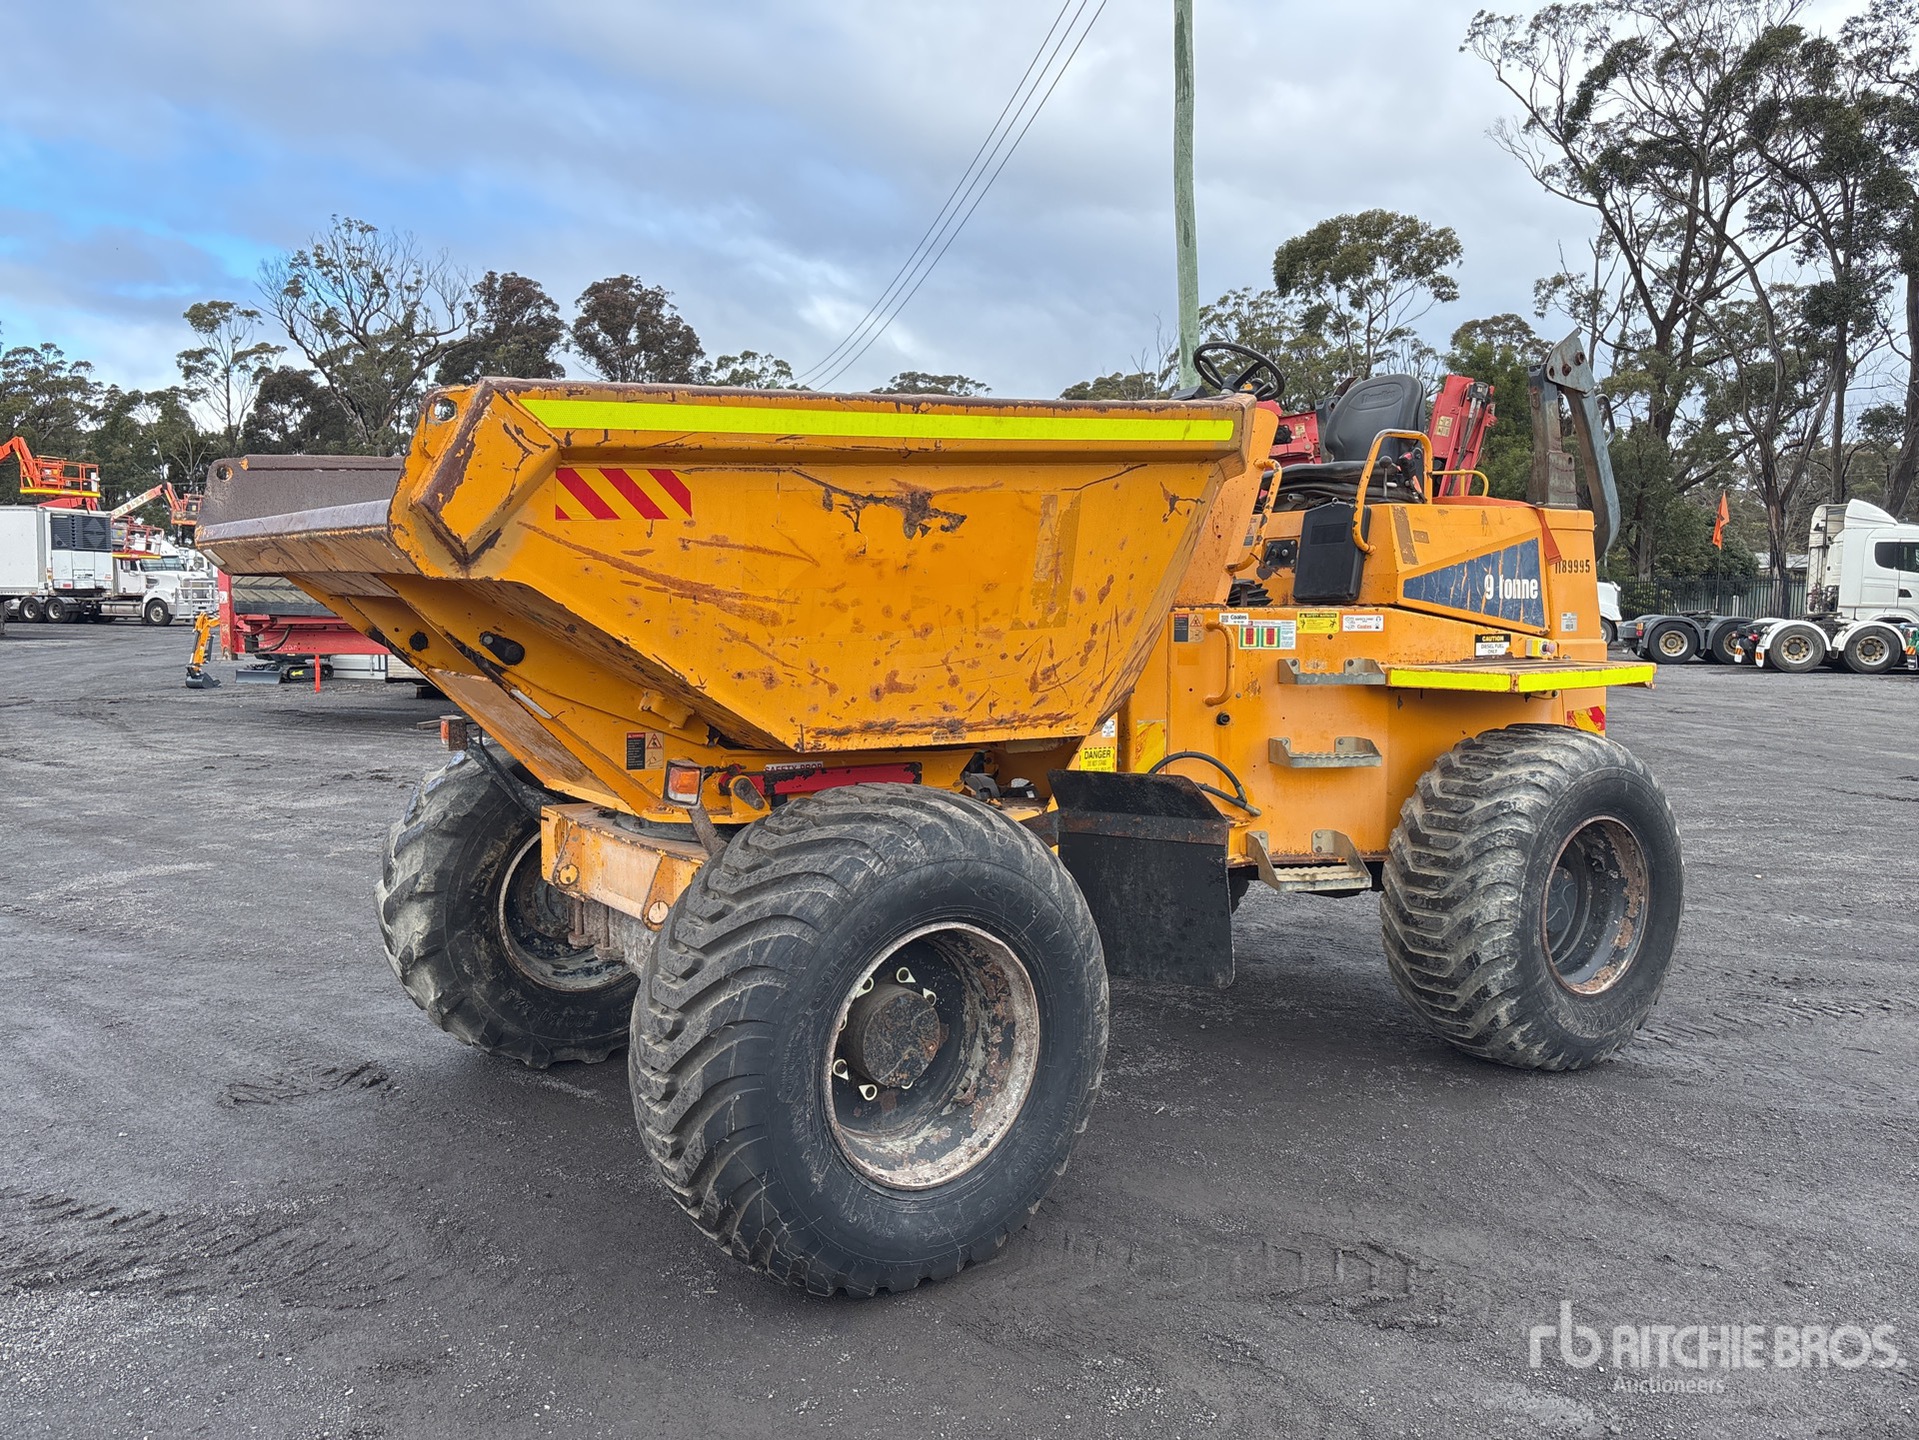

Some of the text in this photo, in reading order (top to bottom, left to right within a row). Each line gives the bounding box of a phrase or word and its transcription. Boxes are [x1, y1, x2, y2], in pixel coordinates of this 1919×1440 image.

[1484, 574, 1539, 600] 9 tonne
[1084, 750, 1111, 760] DANGER
